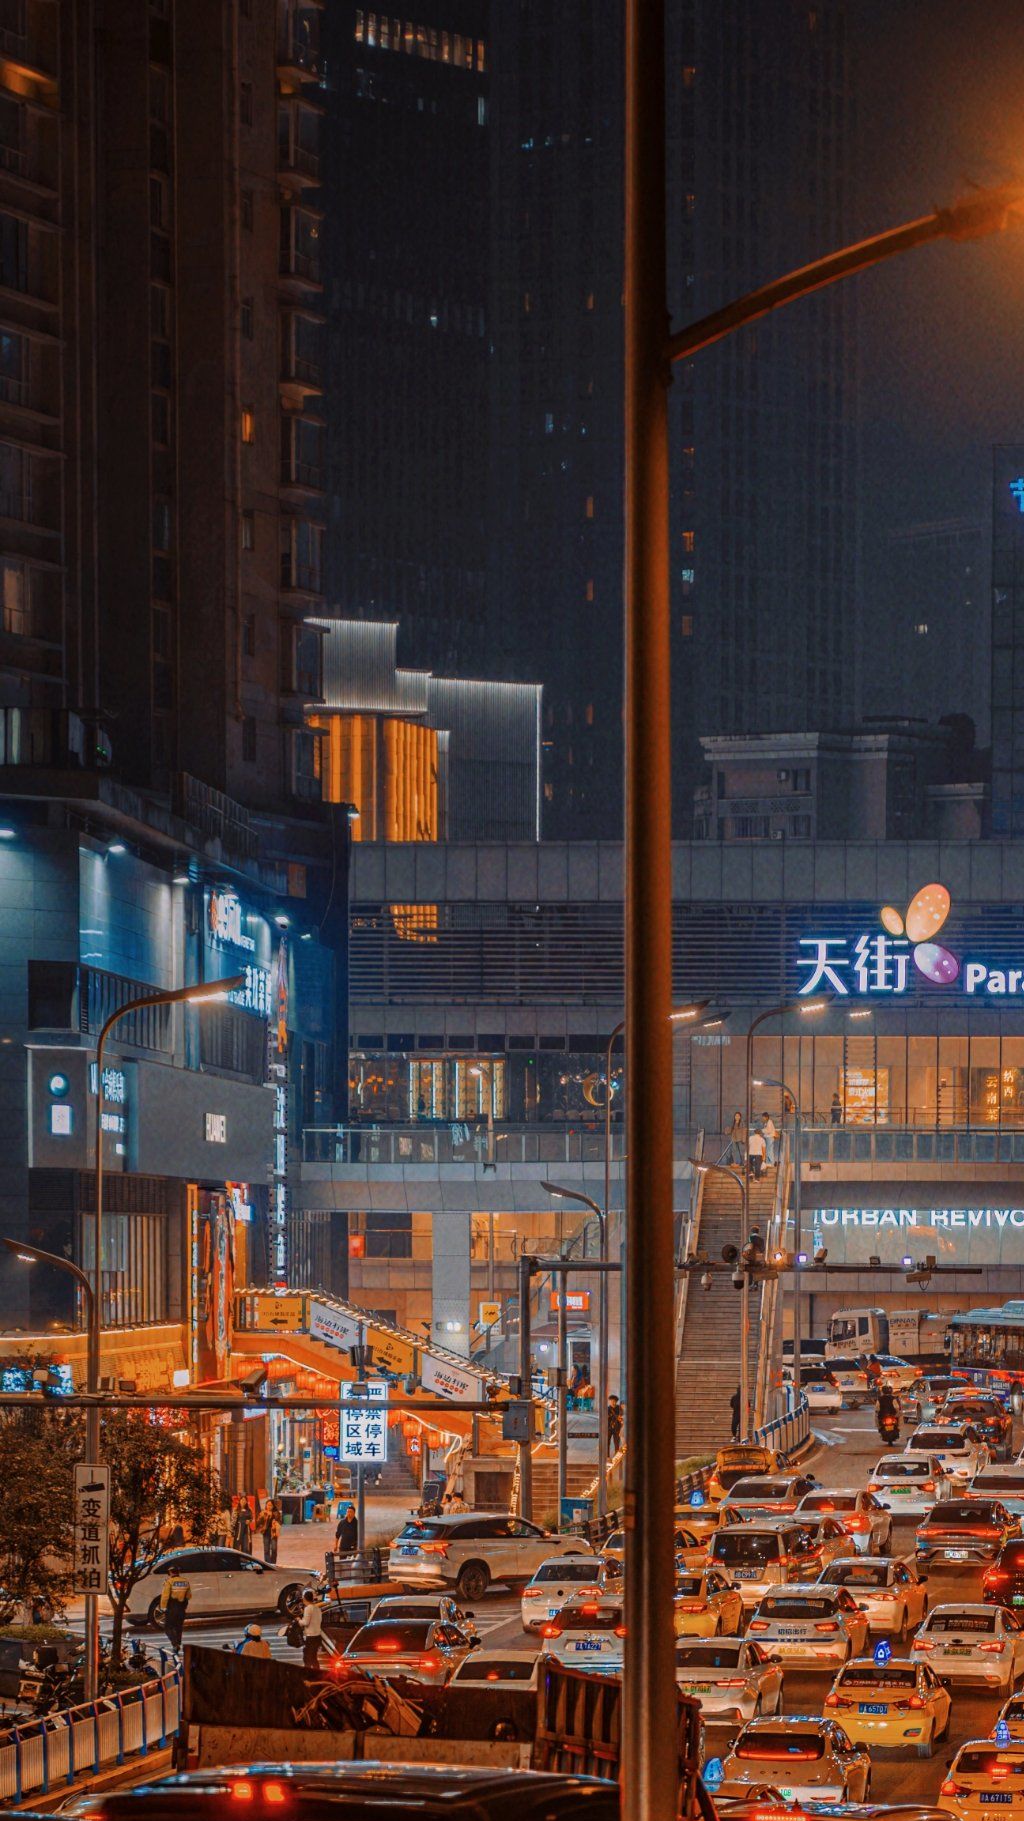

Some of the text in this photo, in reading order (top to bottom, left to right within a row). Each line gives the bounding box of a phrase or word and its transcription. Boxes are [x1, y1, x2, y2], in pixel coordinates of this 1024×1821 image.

[796, 935, 911, 994] 天街
[820, 1210, 917, 1226] URBAN
[80, 1498, 102, 1589] 变道抓拍
[980, 1794, 1013, 1803] A671T5
